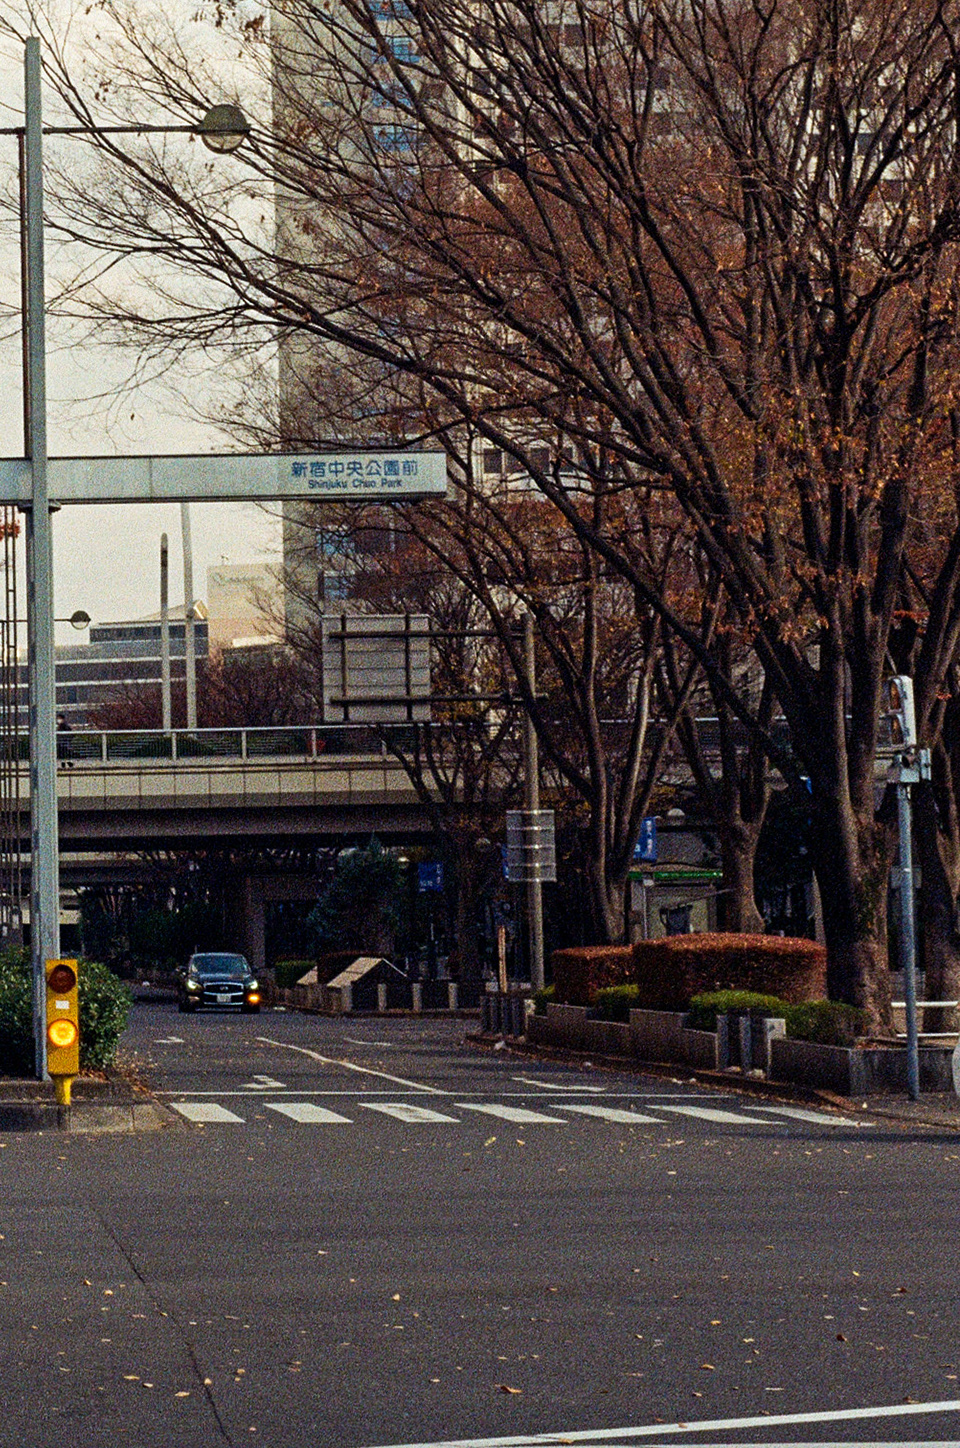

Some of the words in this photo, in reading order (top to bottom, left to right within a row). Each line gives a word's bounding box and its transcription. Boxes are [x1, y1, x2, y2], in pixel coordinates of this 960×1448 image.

[291, 459, 419, 478] 新宿中央公園前
[308, 480, 348, 490] Shinjuku
[352, 478, 376, 488] Chuo
[381, 478, 402, 488] Park
